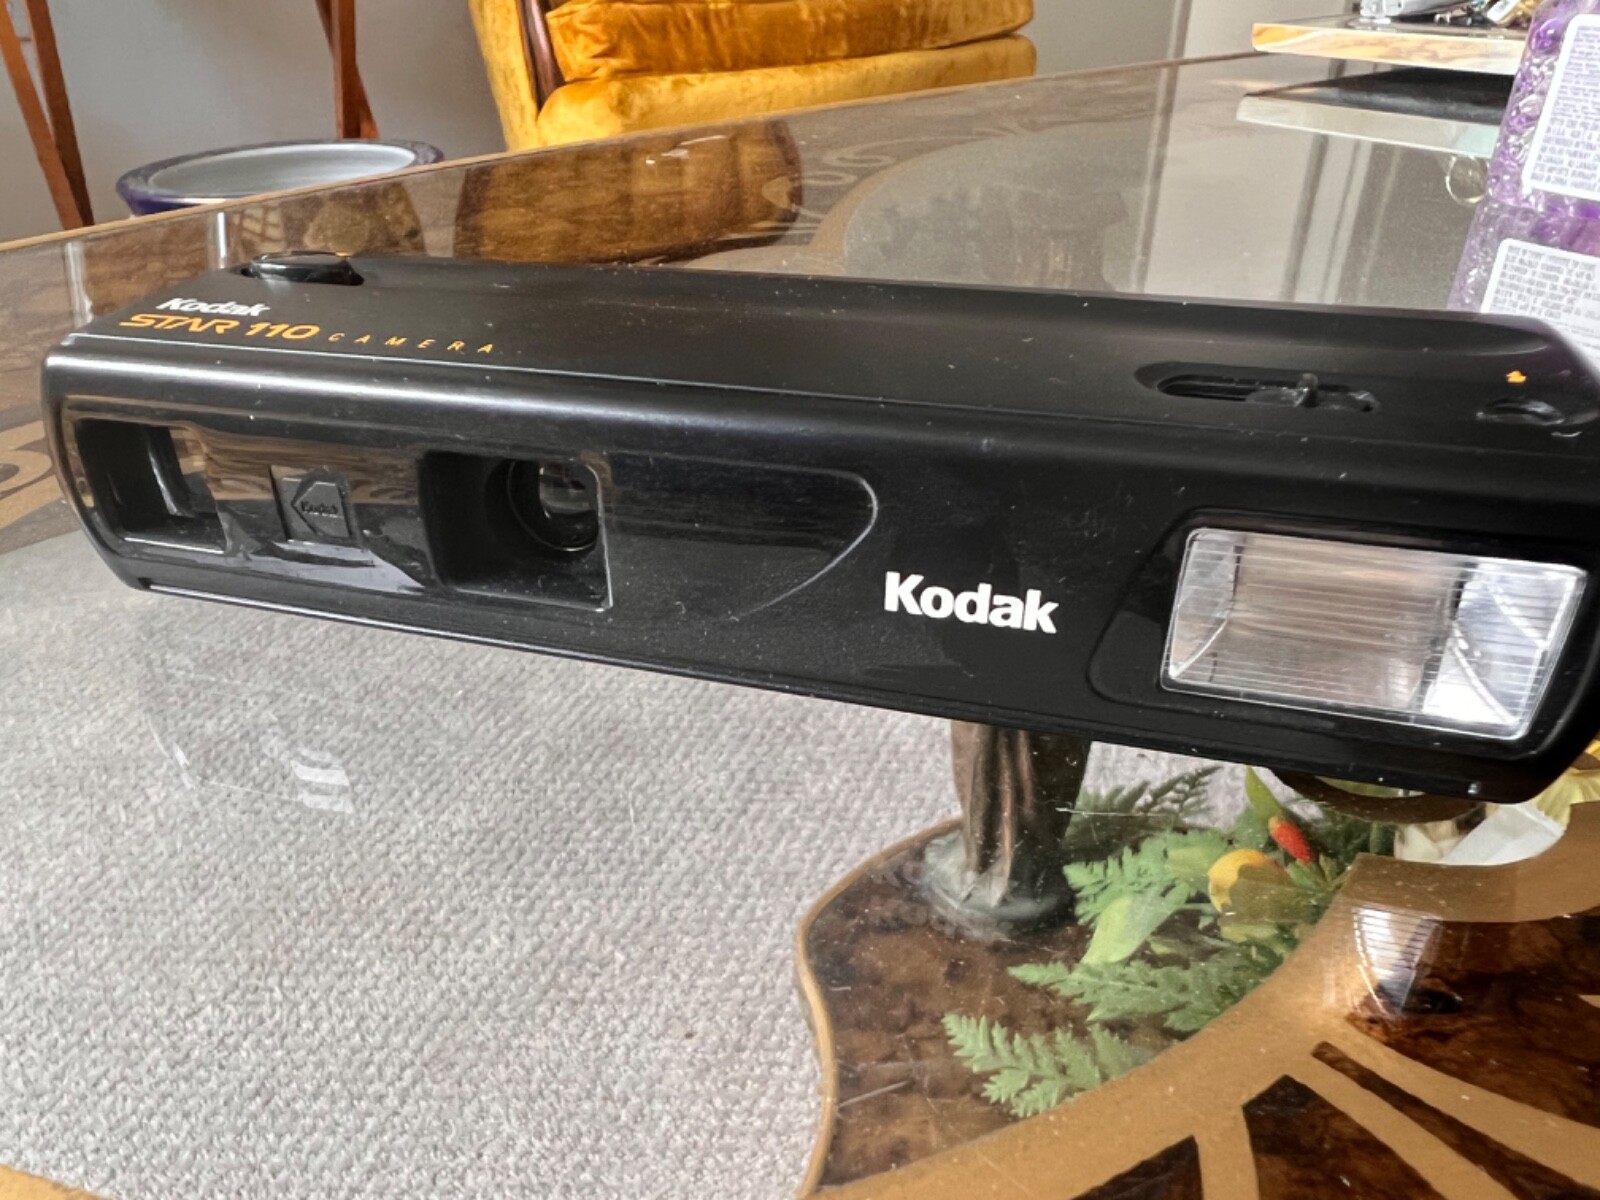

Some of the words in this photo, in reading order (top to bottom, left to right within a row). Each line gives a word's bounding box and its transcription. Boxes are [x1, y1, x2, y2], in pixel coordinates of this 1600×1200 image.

[155, 297, 270, 317] Kodak
[119, 313, 240, 335] STAR
[245, 321, 320, 341] 110
[328, 332, 493, 354] CAMERA
[884, 570, 1059, 634] Kodak
